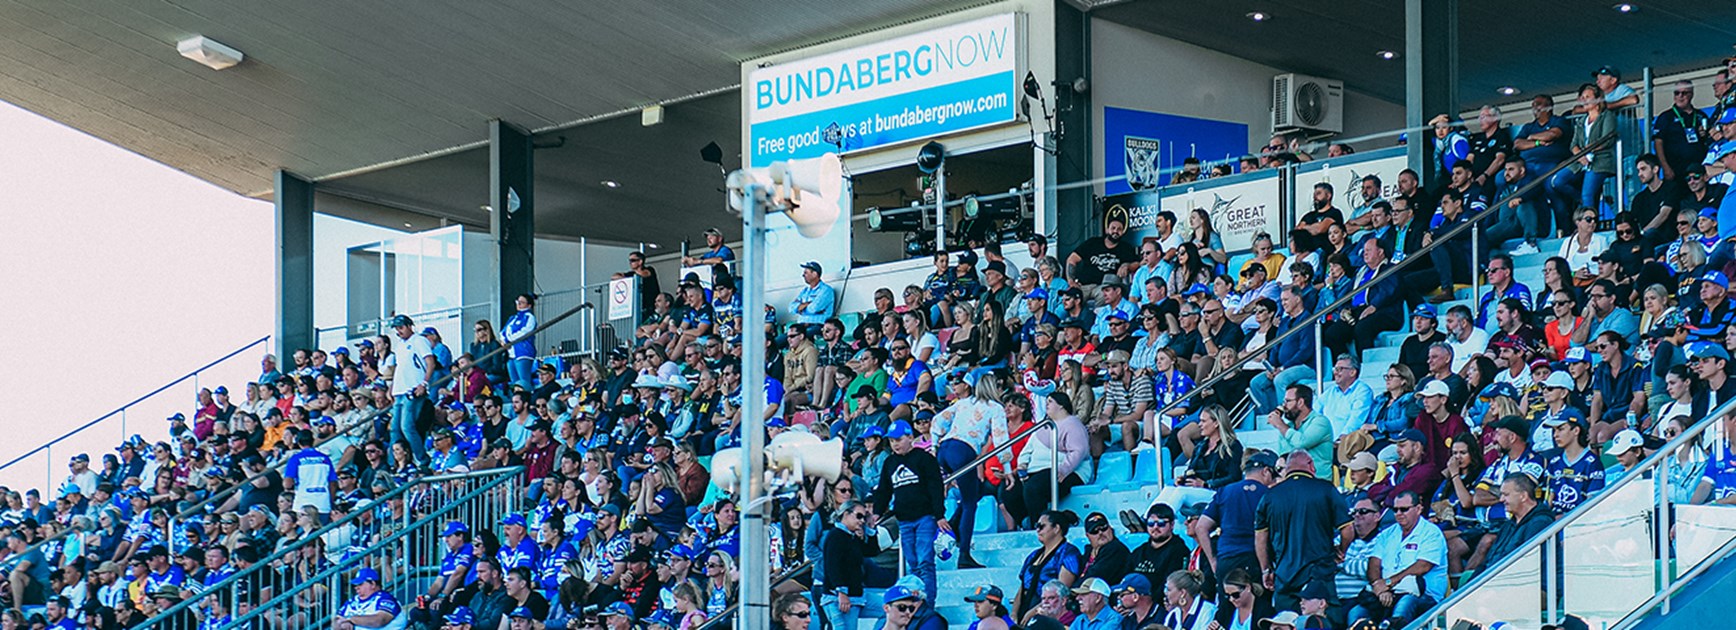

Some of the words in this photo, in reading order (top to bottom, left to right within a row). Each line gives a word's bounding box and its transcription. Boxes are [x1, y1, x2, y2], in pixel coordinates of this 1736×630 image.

[757, 26, 1008, 111] BUNDABERGNOW
[758, 137, 785, 156] Free
[787, 126, 820, 154] good
[859, 117, 872, 136] at
[875, 91, 1008, 133] bundabergnow.com
[1127, 139, 1157, 150] BULLDOGS
[1129, 204, 1156, 217] KALKI
[1227, 205, 1265, 222] GREAT
[1129, 215, 1156, 228] MOON
[1227, 217, 1266, 231] NORTHERN
